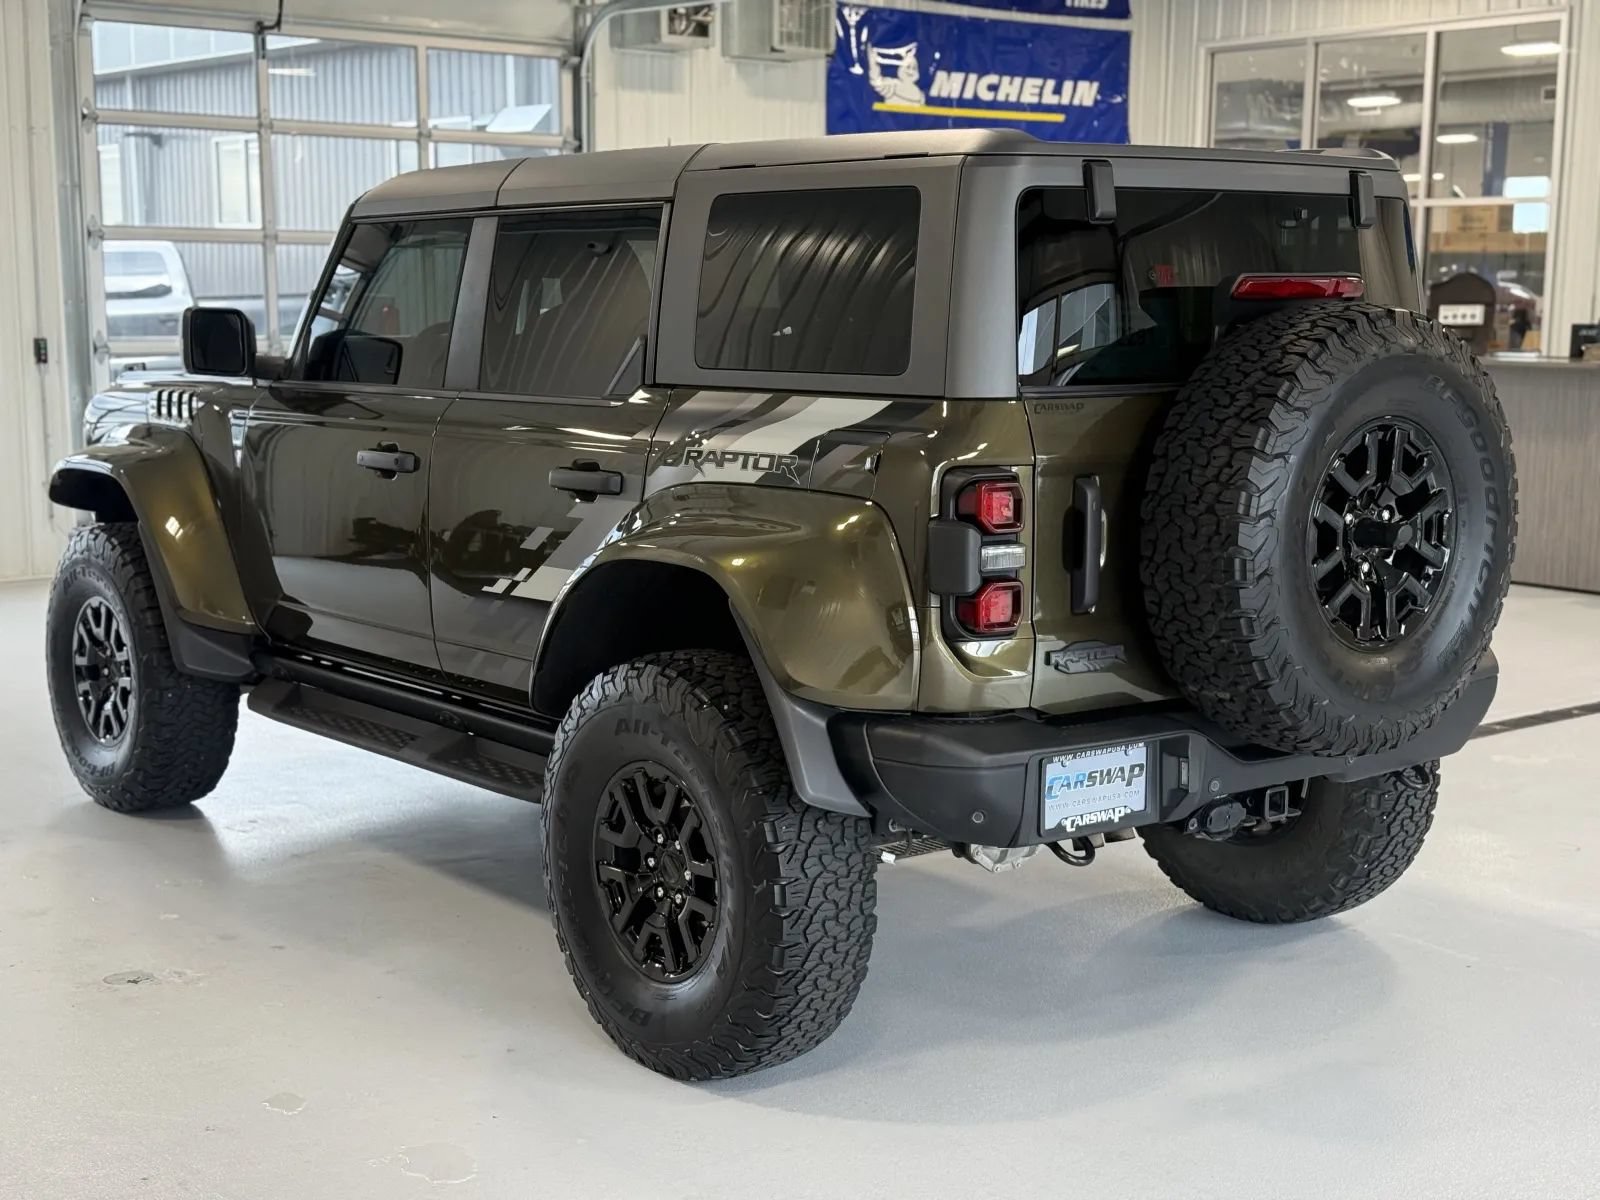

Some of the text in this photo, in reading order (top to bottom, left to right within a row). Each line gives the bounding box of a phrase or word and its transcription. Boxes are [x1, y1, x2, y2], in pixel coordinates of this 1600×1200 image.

[929, 71, 1099, 107] MICHELIN
[682, 446, 801, 486] RAPTOR
[1045, 763, 1145, 800] CARSWAP
[1065, 806, 1126, 832] CARSWAP
